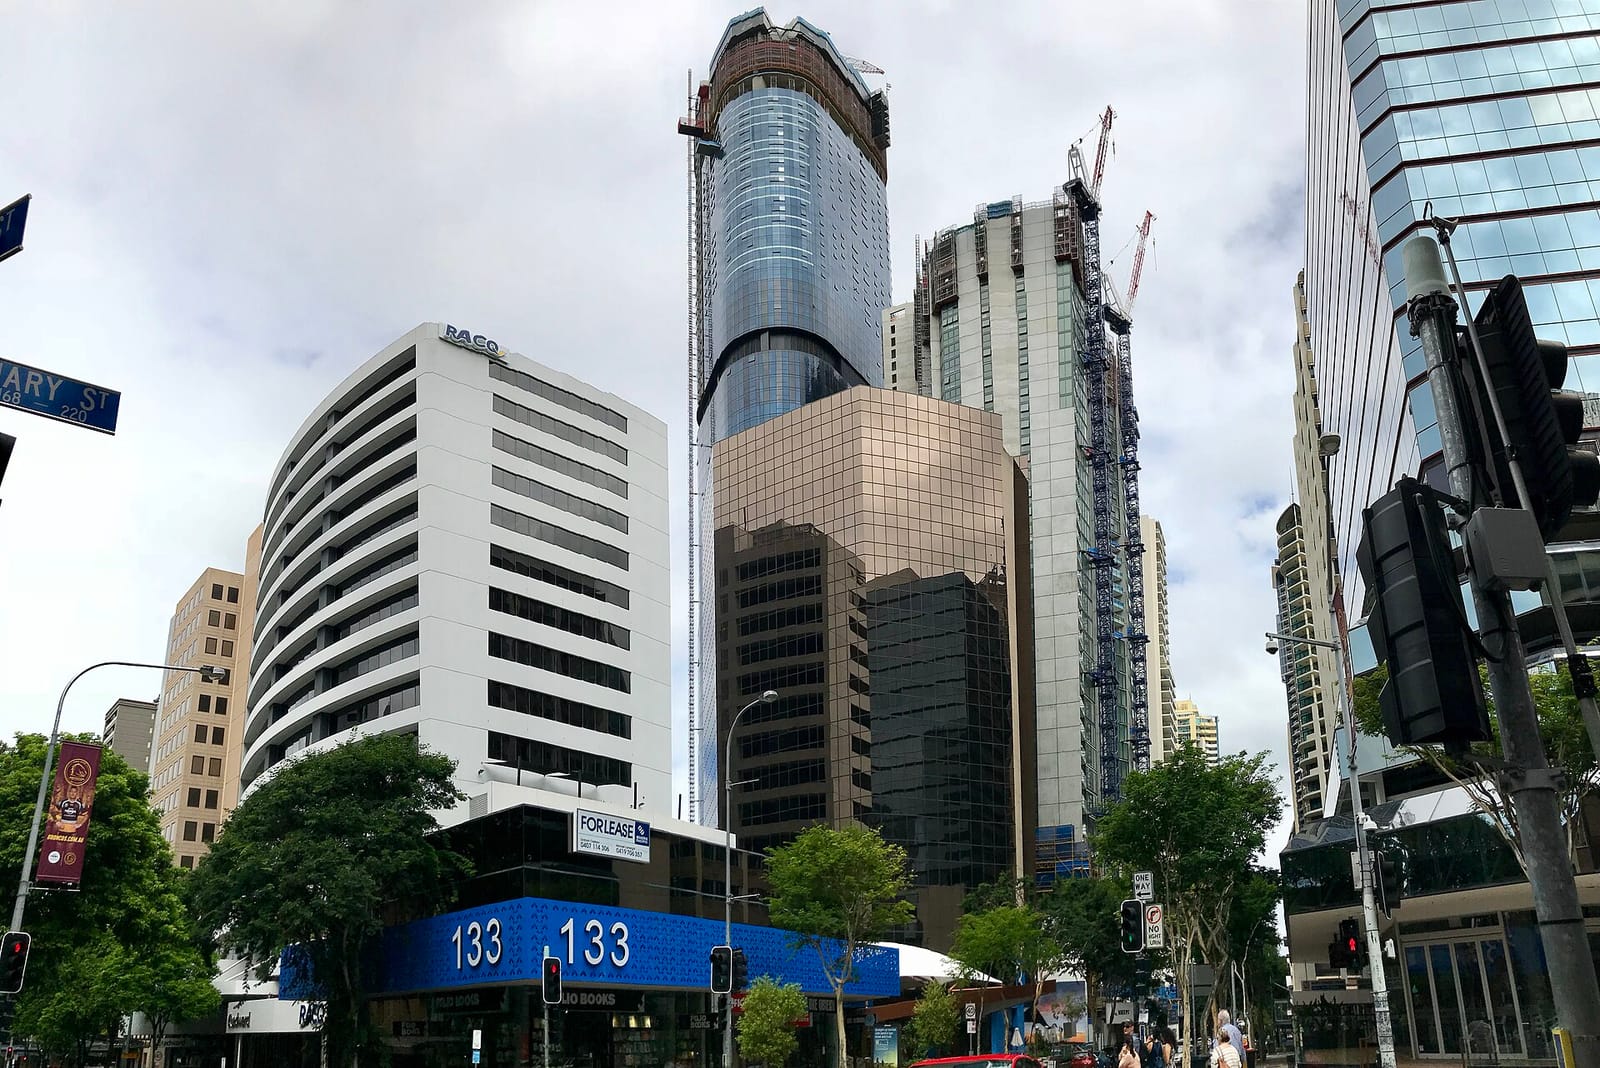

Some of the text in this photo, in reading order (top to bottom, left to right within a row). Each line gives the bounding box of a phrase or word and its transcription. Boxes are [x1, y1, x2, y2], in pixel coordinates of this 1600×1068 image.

[445, 323, 499, 355] RACQ
[0, 362, 110, 412] ARY ST
[61, 404, 88, 424] 220
[580, 815, 634, 839] FOR LEASE
[1135, 874, 1149, 882] ONE
[1135, 882, 1150, 891] WAY
[1148, 925, 1160, 933] NO
[451, 917, 503, 970] 133
[560, 917, 631, 968] 133
[562, 992, 616, 1006] LIO BOOKS
